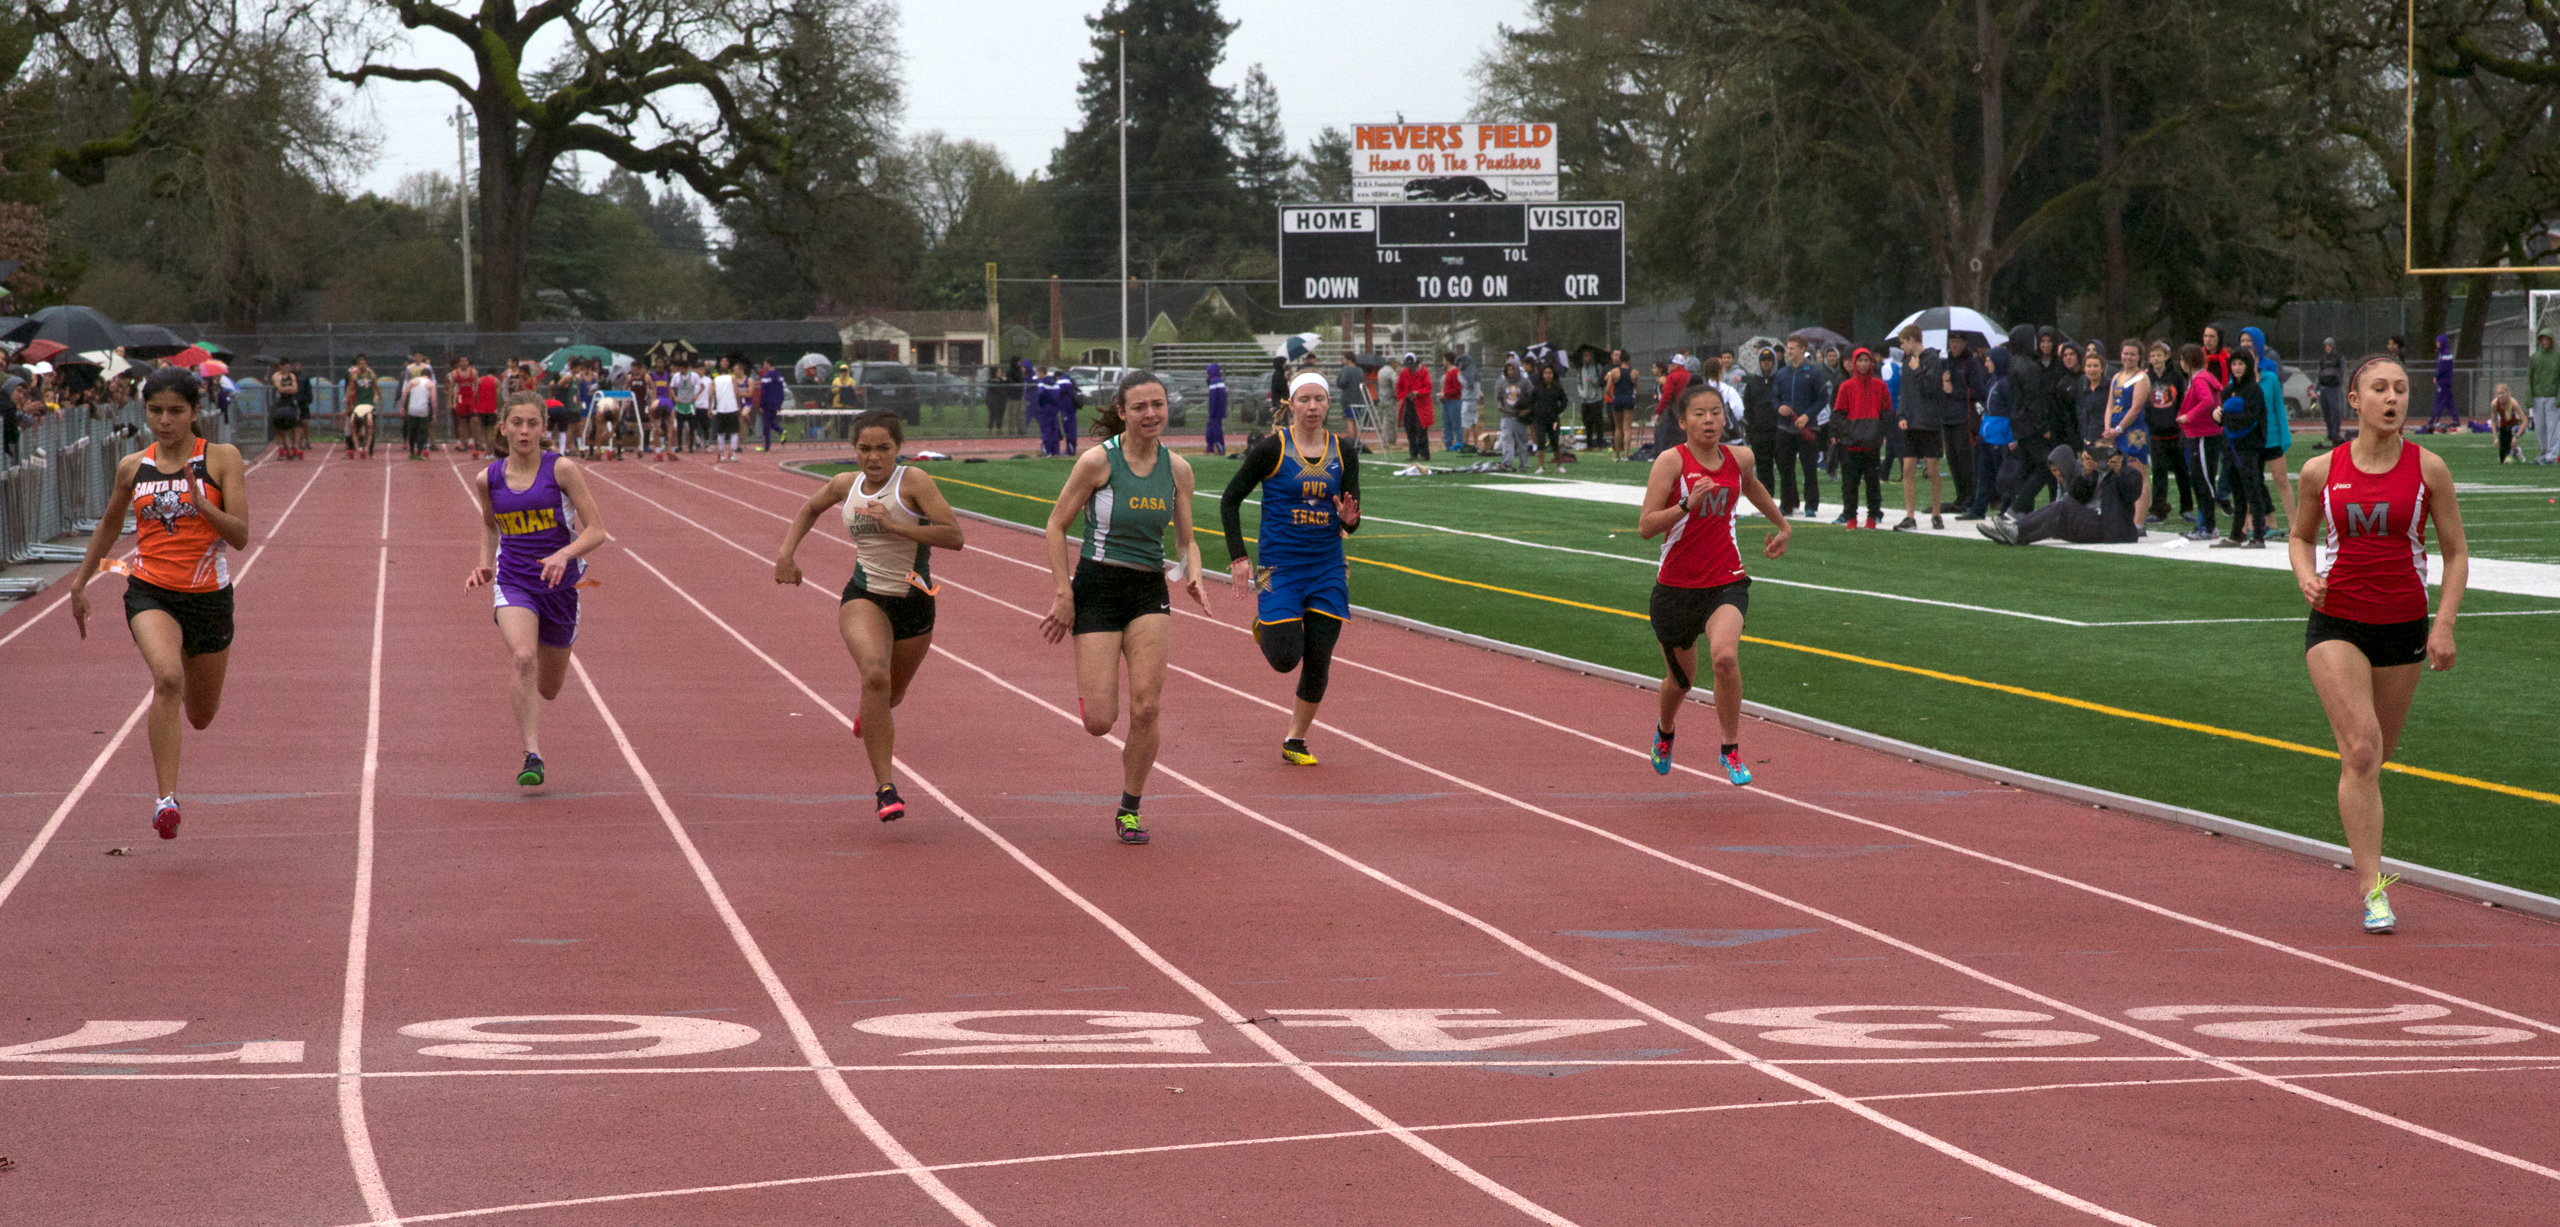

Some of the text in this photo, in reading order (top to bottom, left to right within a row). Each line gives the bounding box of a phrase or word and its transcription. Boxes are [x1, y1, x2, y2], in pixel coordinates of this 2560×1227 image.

[1356, 124, 1553, 151] NEVERS FIELD
[1369, 153, 1542, 173] Home Of The Panthers
[1297, 212, 1362, 229] HOME
[1533, 209, 1617, 227] VISITOR
[1377, 250, 1401, 263] TOL
[1503, 249, 1528, 261] TOL
[1305, 276, 1359, 299] DOWN
[1417, 275, 1508, 298] TO GO ON
[1564, 273, 1600, 299] QTR
[133, 478, 206, 501] SANTA ROA
[1302, 481, 1327, 498] RVC
[1129, 496, 1167, 511] CASA
[1699, 486, 1730, 517] M
[494, 507, 558, 535] UKIAH
[1291, 509, 1330, 526] TRACK
[2345, 502, 2390, 537] M
[852, 1009, 1212, 1056] 5
[1264, 1007, 1648, 1052] 4
[1705, 1005, 2101, 1049] 3
[2124, 1003, 2538, 1047] 2
